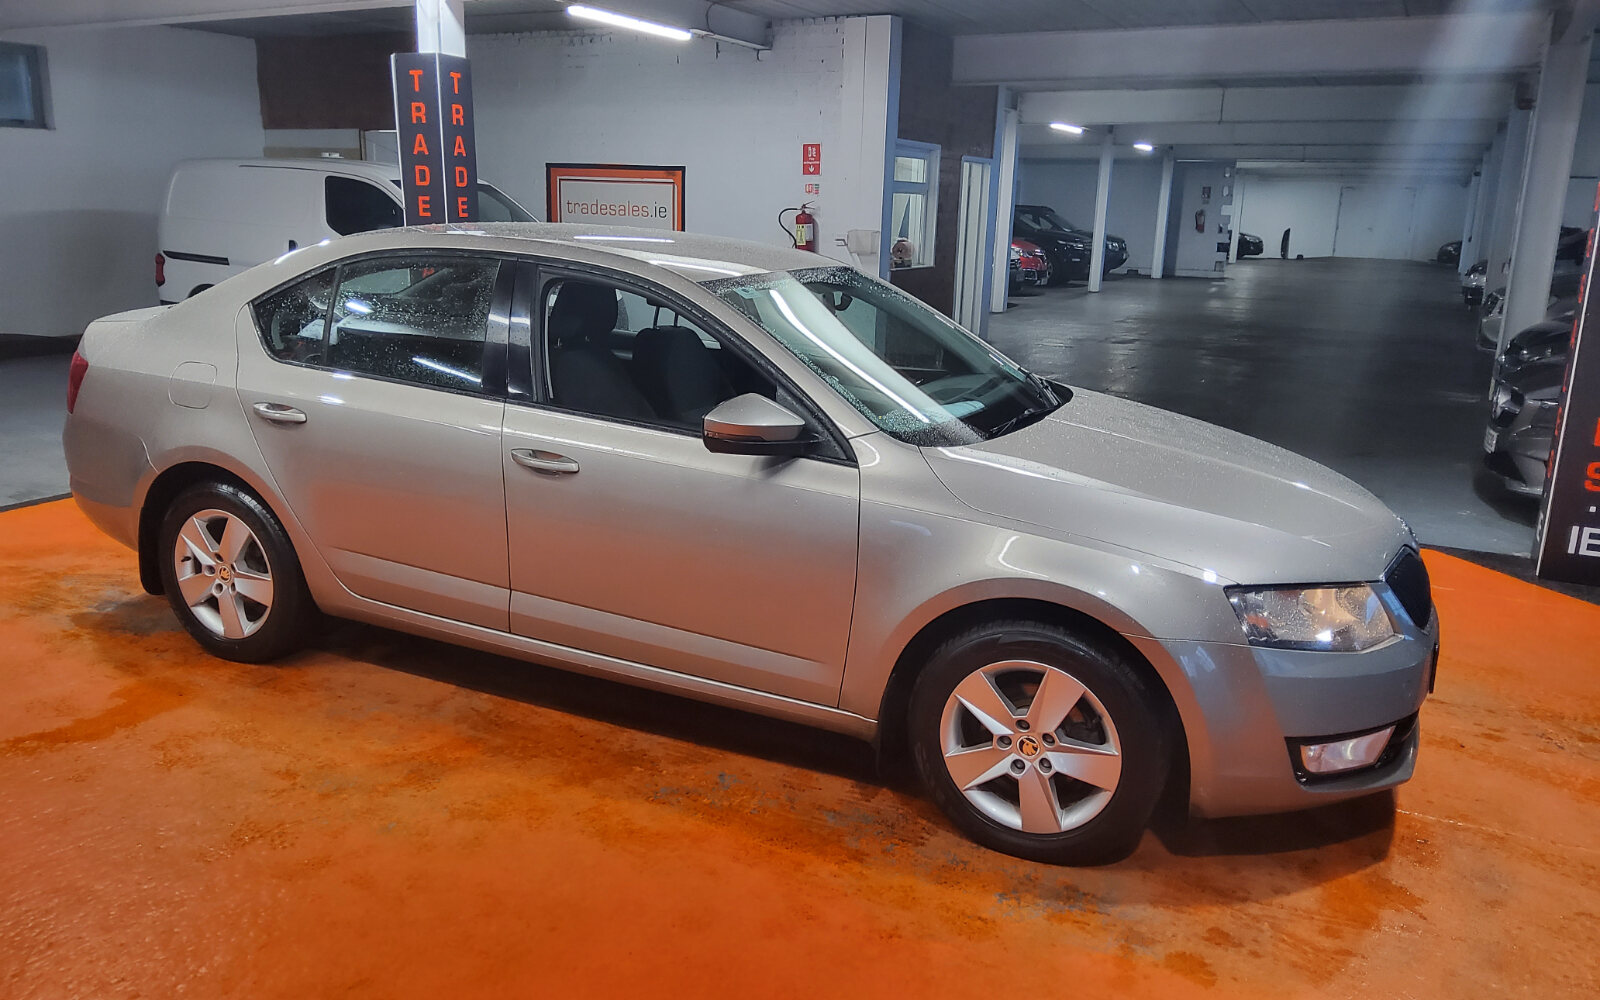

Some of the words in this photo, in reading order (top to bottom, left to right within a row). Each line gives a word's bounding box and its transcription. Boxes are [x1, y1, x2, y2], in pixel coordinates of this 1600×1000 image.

[409, 69, 431, 217] TRADE
[450, 71, 469, 218] TRADE
[566, 199, 667, 219] tradesales.ie
